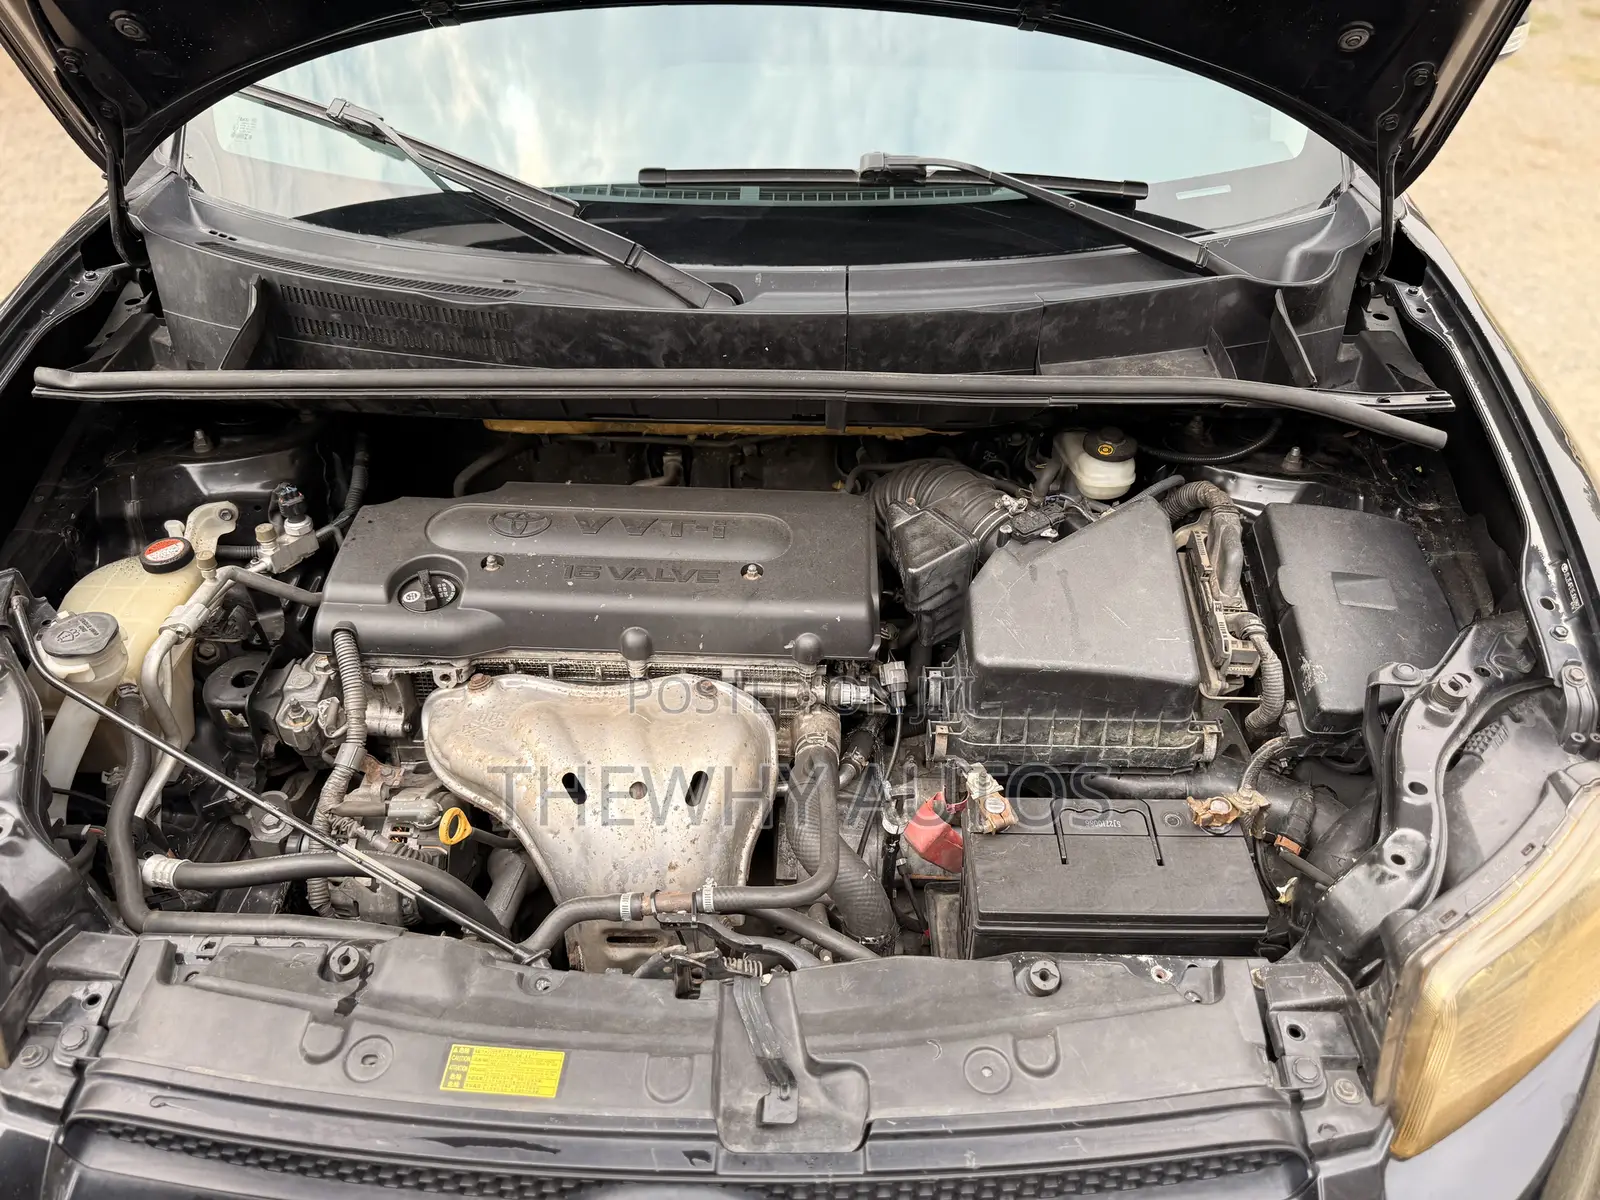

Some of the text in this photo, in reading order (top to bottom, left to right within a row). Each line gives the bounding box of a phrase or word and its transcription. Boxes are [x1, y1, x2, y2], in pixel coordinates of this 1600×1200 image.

[573, 513, 727, 539] VVT-i
[563, 563, 721, 584] 16 VALVE
